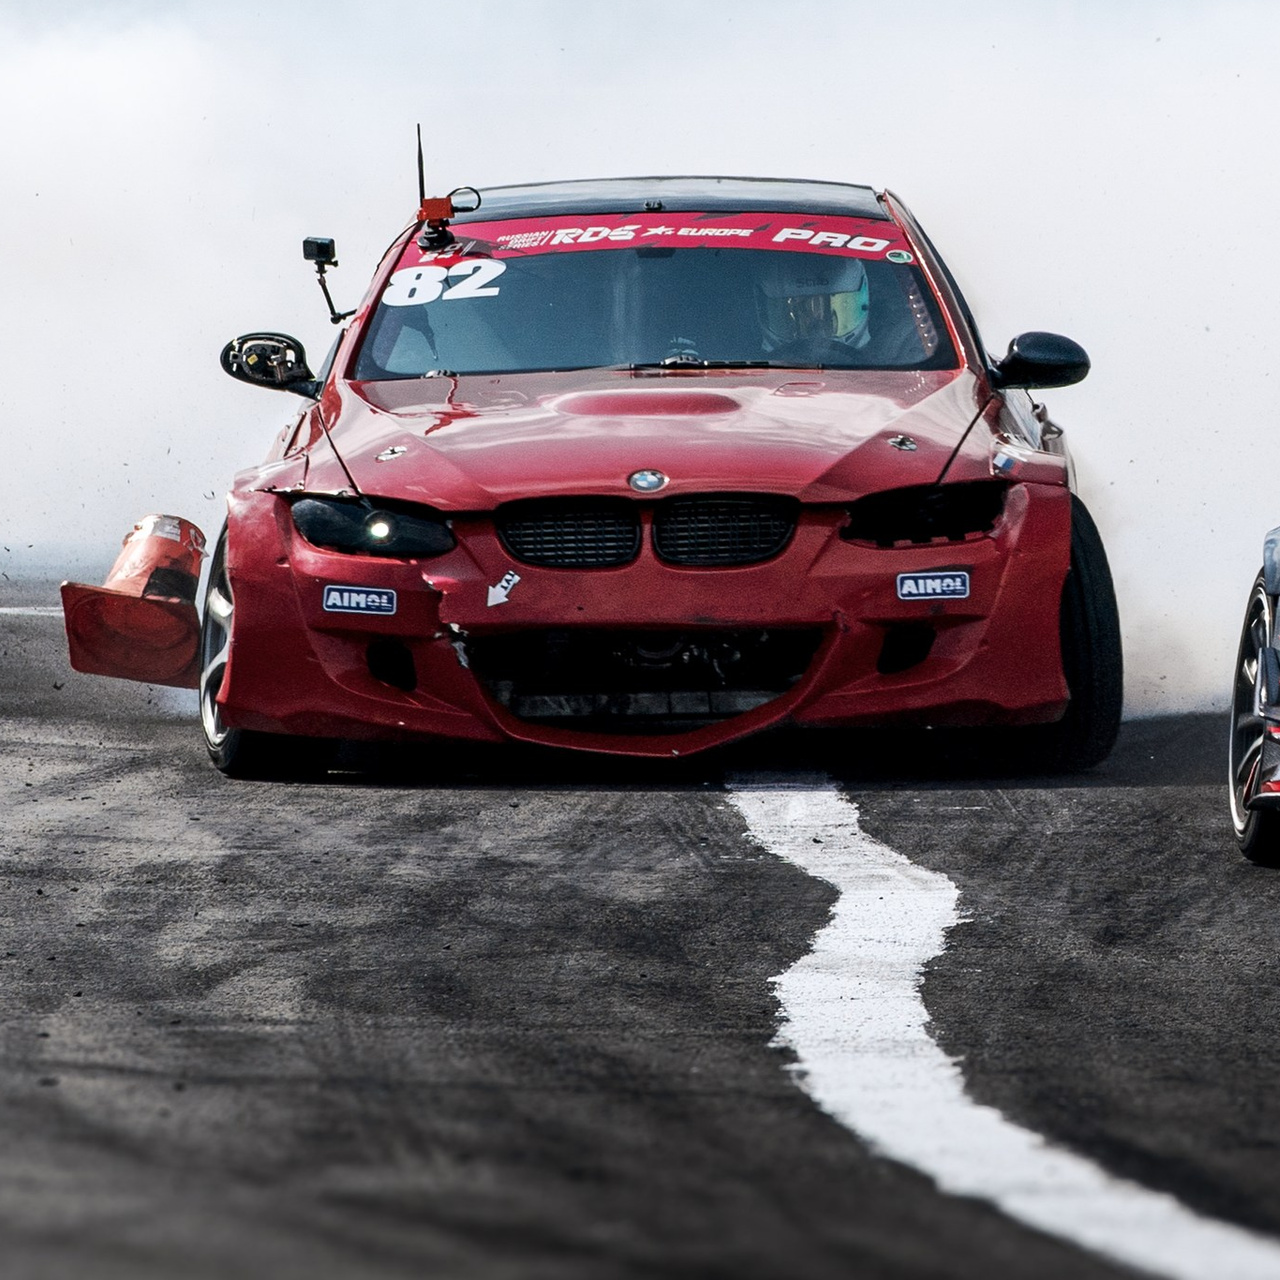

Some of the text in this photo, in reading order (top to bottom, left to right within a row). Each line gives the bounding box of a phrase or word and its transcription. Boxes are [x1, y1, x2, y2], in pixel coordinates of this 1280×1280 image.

[550, 225, 891, 252] RDS EUROPE PRO
[382, 259, 507, 306] 82
[901, 577, 966, 595] AIMOL
[326, 591, 393, 610] AIMOL
